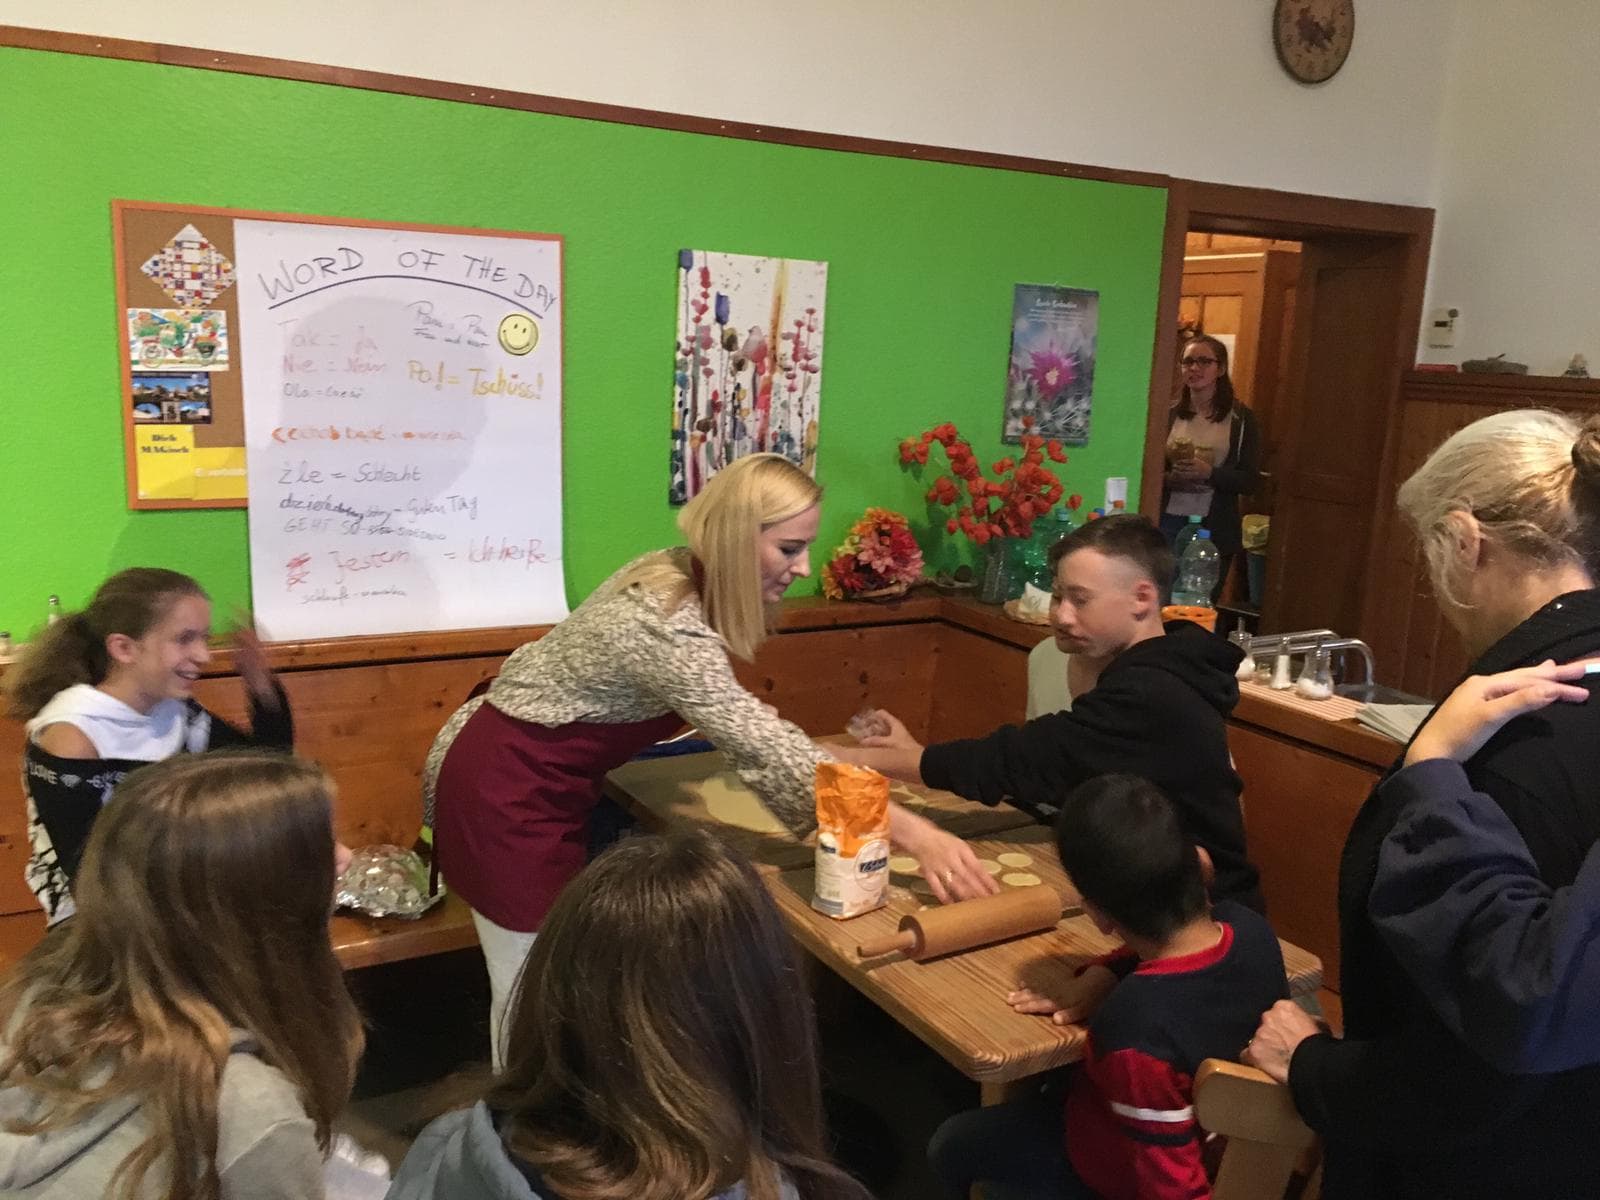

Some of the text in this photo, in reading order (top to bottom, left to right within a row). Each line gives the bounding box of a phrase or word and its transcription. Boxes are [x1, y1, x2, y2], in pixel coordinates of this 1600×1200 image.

[257, 247, 558, 312] WORD OF THE DAY
